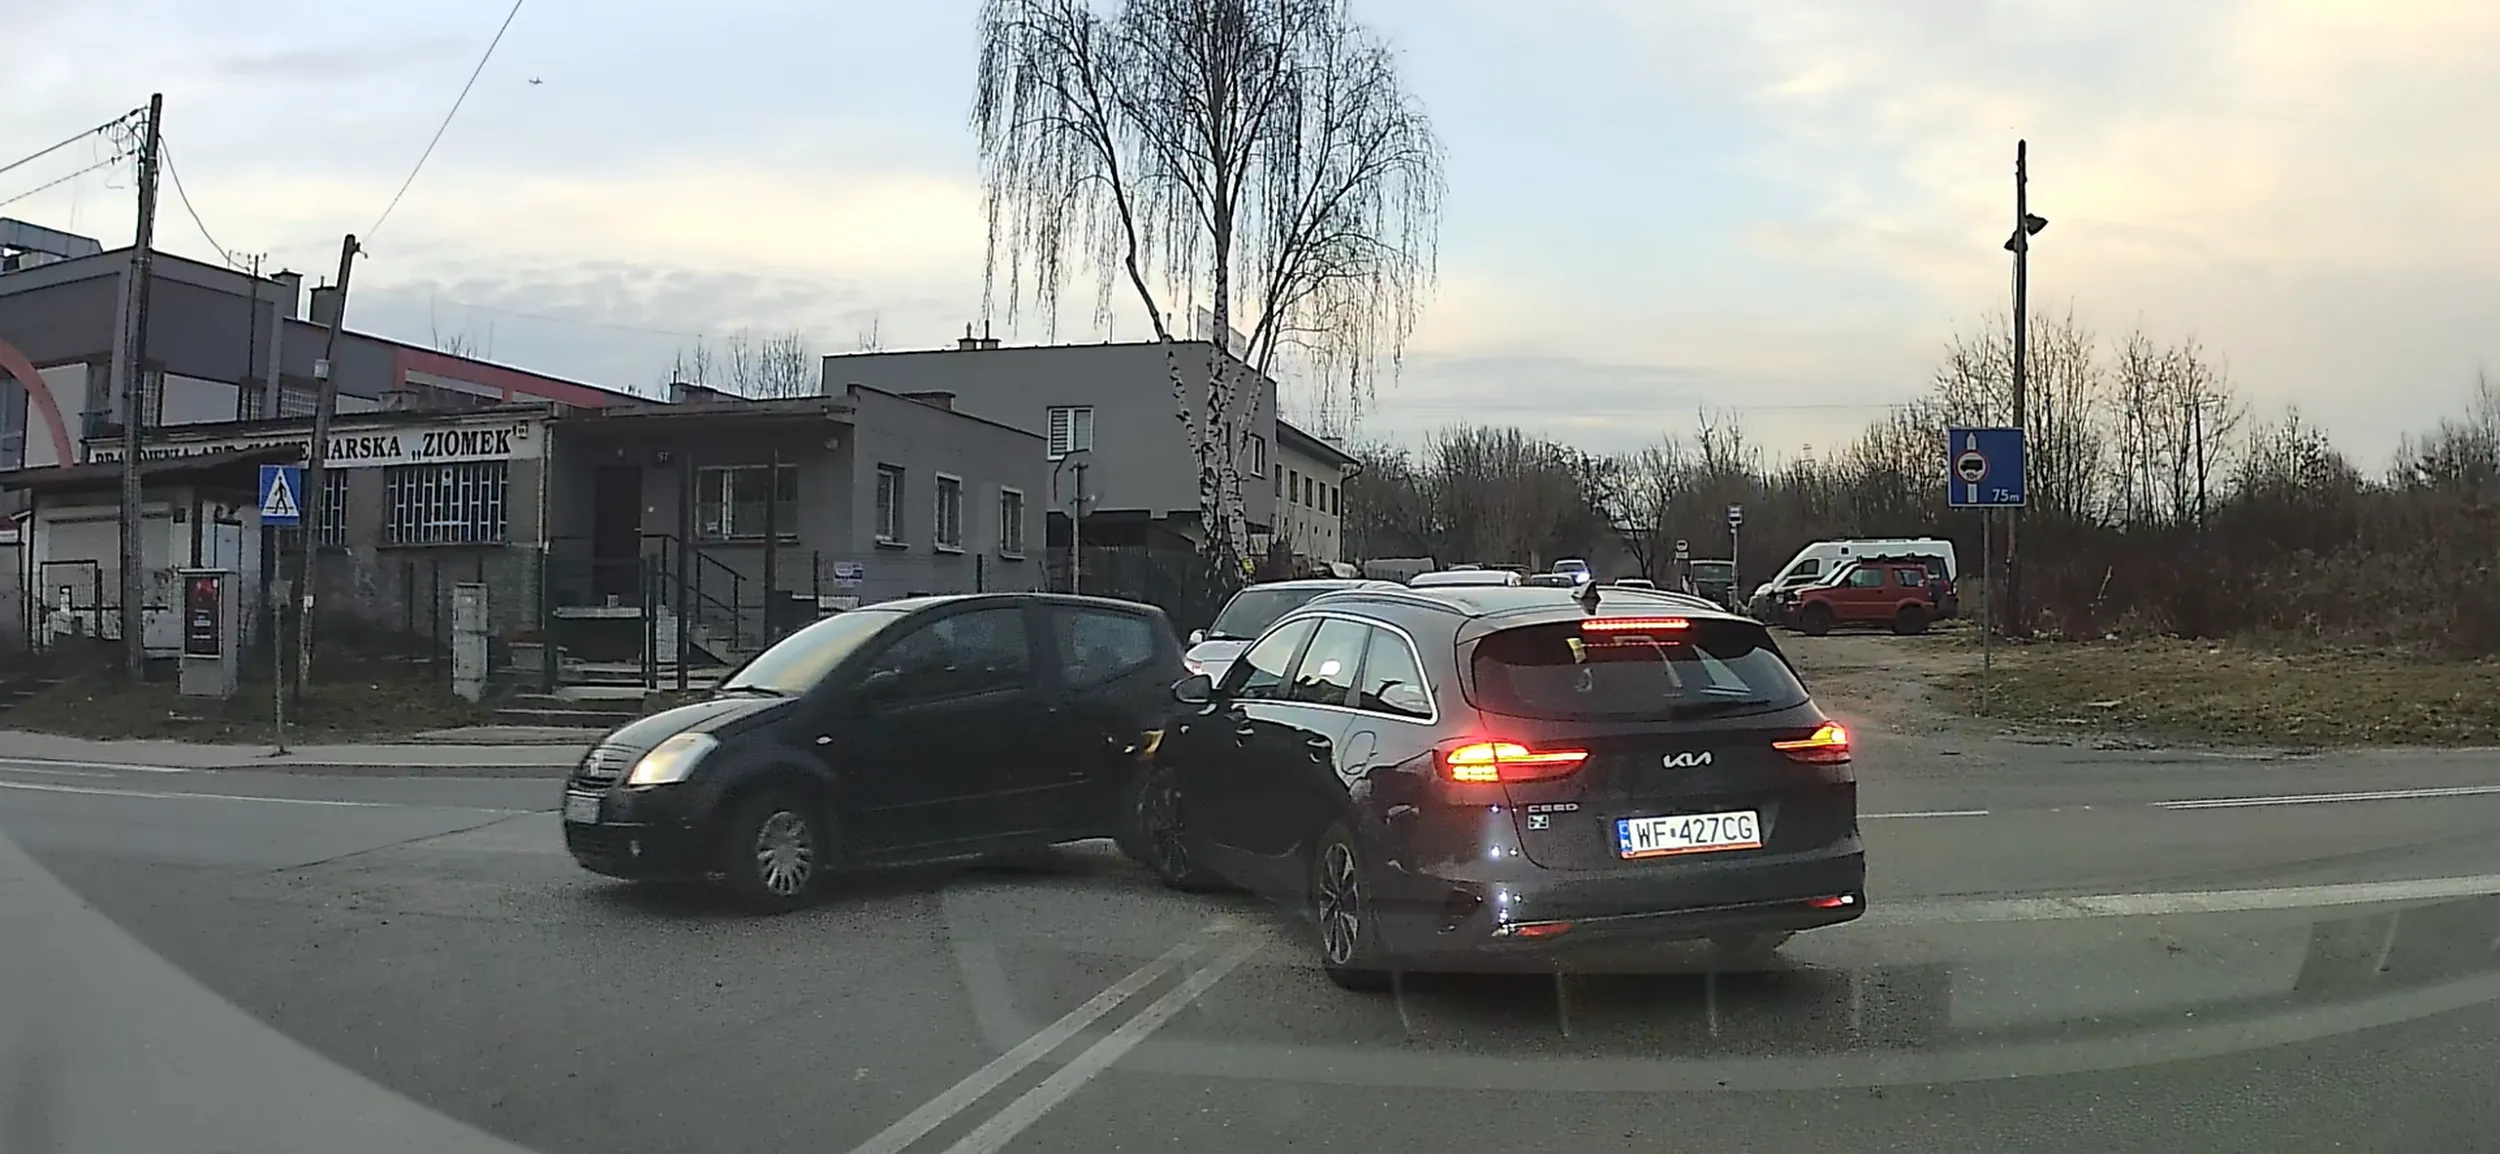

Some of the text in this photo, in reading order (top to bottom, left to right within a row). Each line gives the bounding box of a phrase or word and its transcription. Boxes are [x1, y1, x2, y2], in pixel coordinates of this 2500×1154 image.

[1662, 751, 1713, 768] KIA
[1635, 821, 1667, 848] WF
[1679, 815, 1753, 844] 427CG
